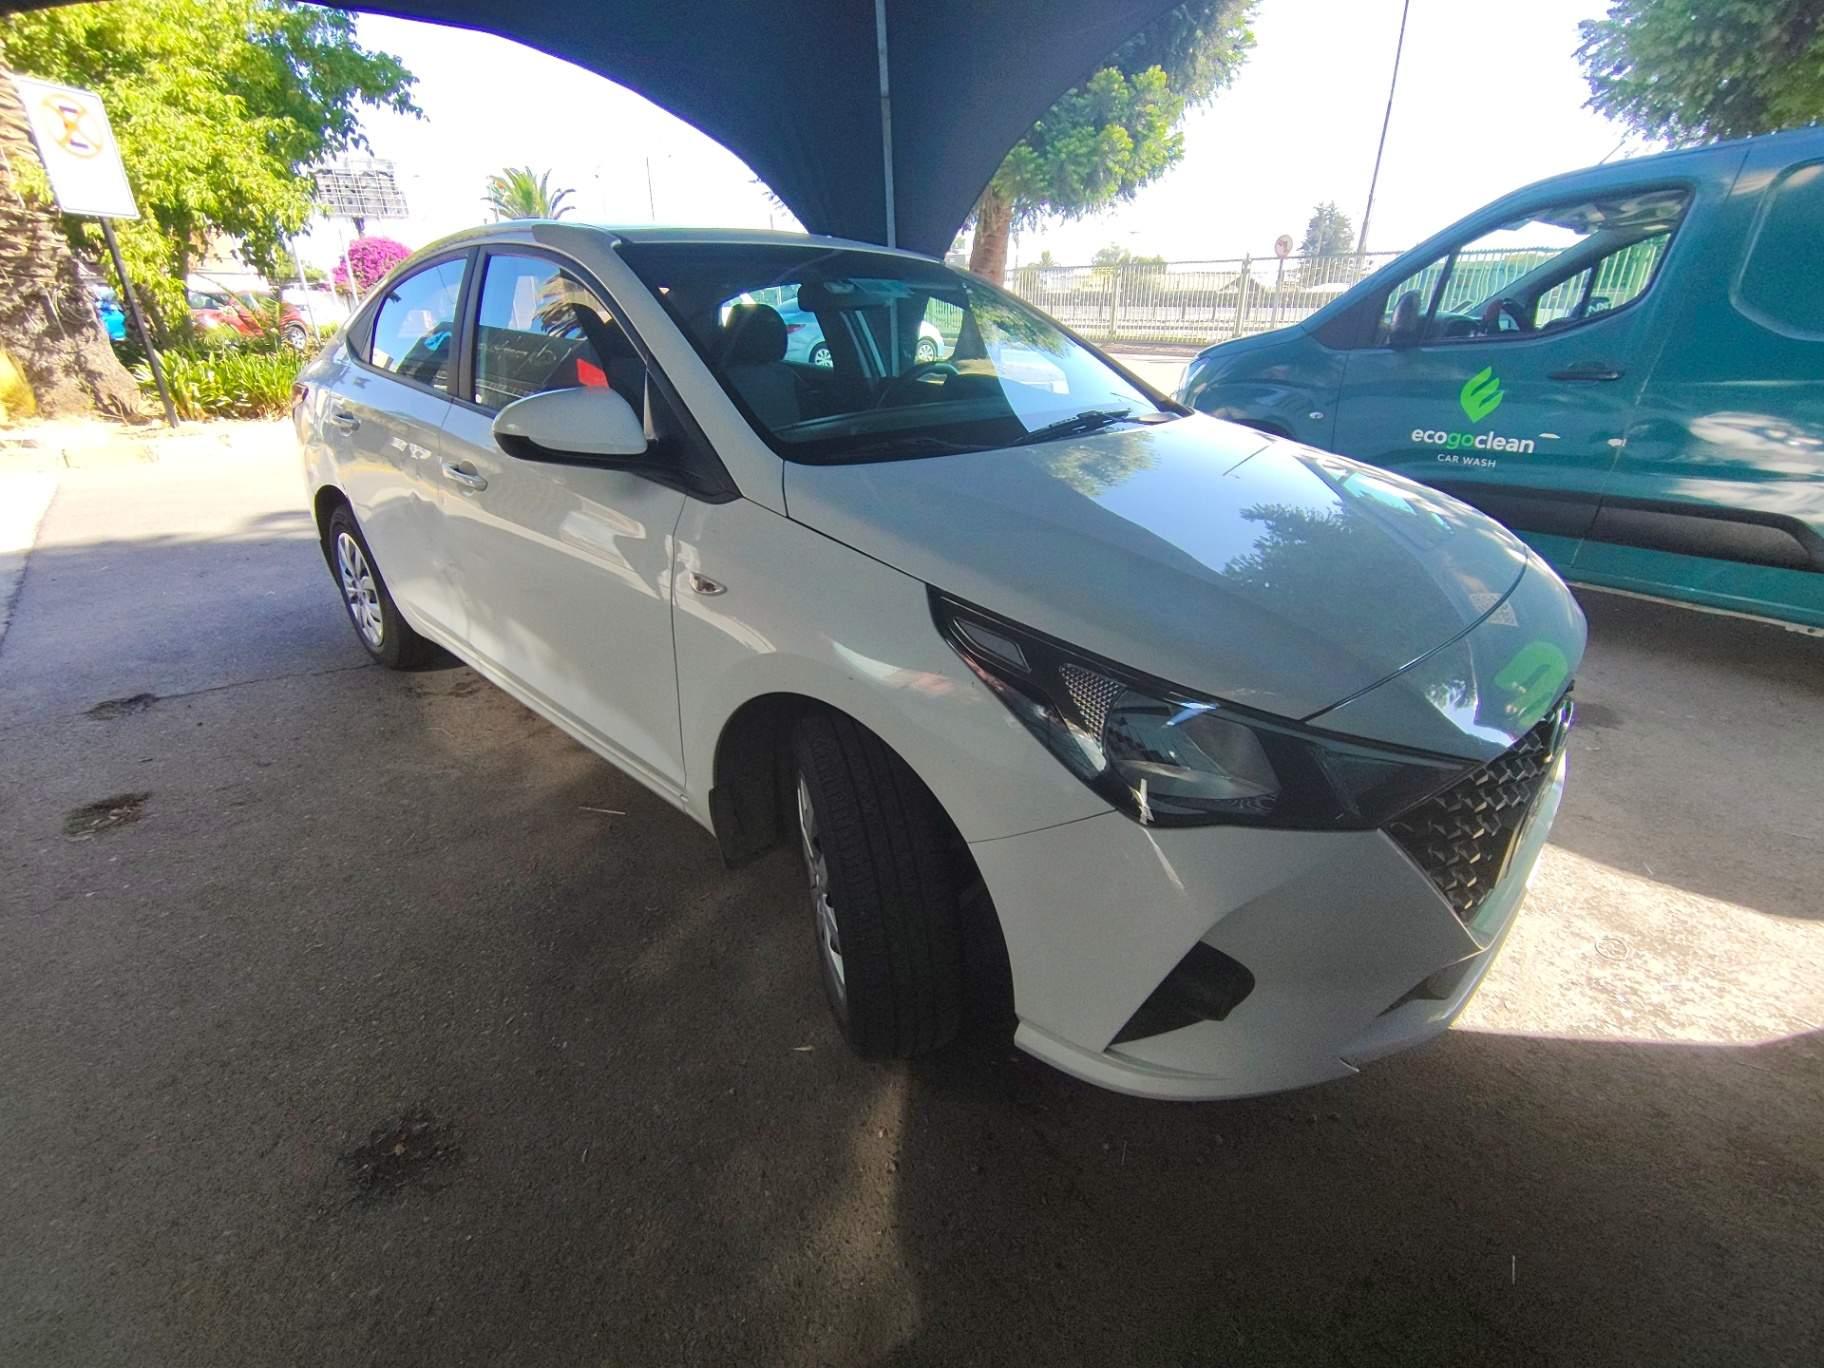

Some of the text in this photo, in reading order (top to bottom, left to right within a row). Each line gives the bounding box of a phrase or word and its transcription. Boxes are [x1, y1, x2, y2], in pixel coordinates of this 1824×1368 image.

[1411, 428, 1535, 453] ecogoclean
[1437, 453, 1496, 467] CAR WASH
